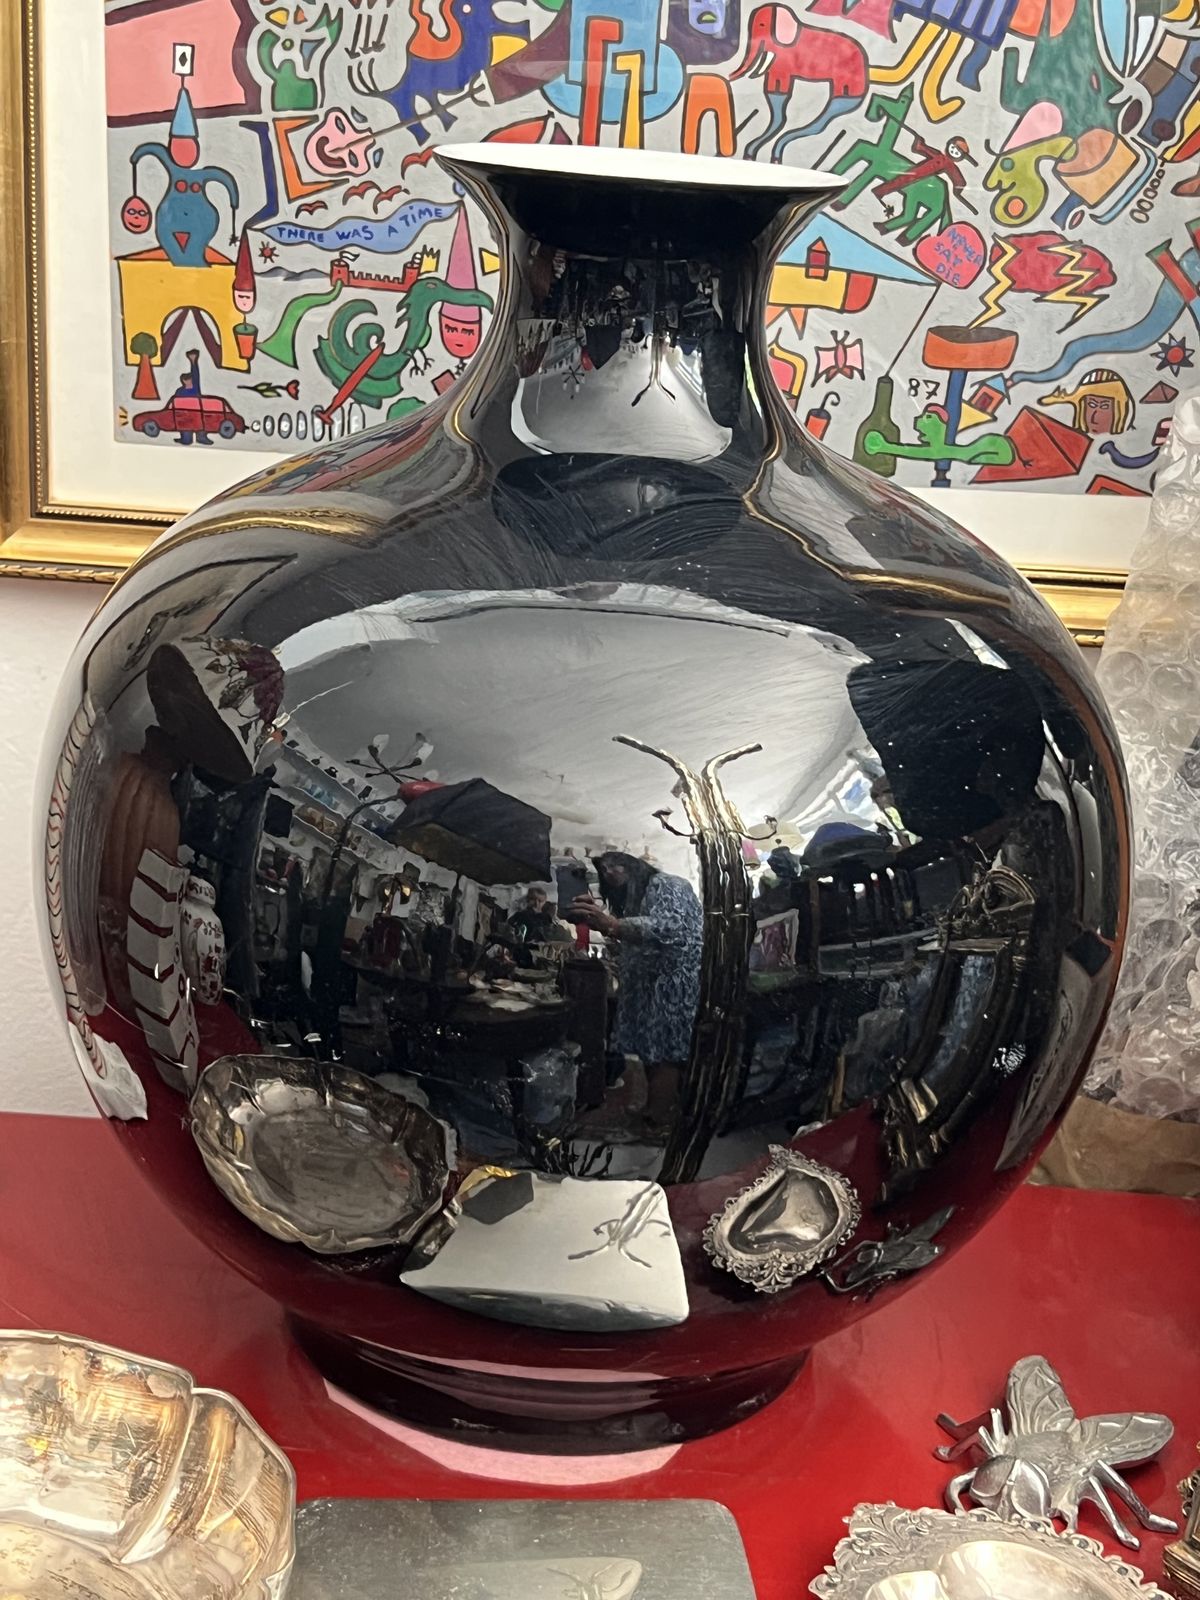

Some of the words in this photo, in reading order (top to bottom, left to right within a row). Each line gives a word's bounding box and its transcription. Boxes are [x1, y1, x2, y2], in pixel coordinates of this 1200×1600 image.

[277, 226, 324, 243] THERE
[335, 225, 374, 241] WAS
[387, 225, 398, 237] A
[907, 377, 941, 400] 87
